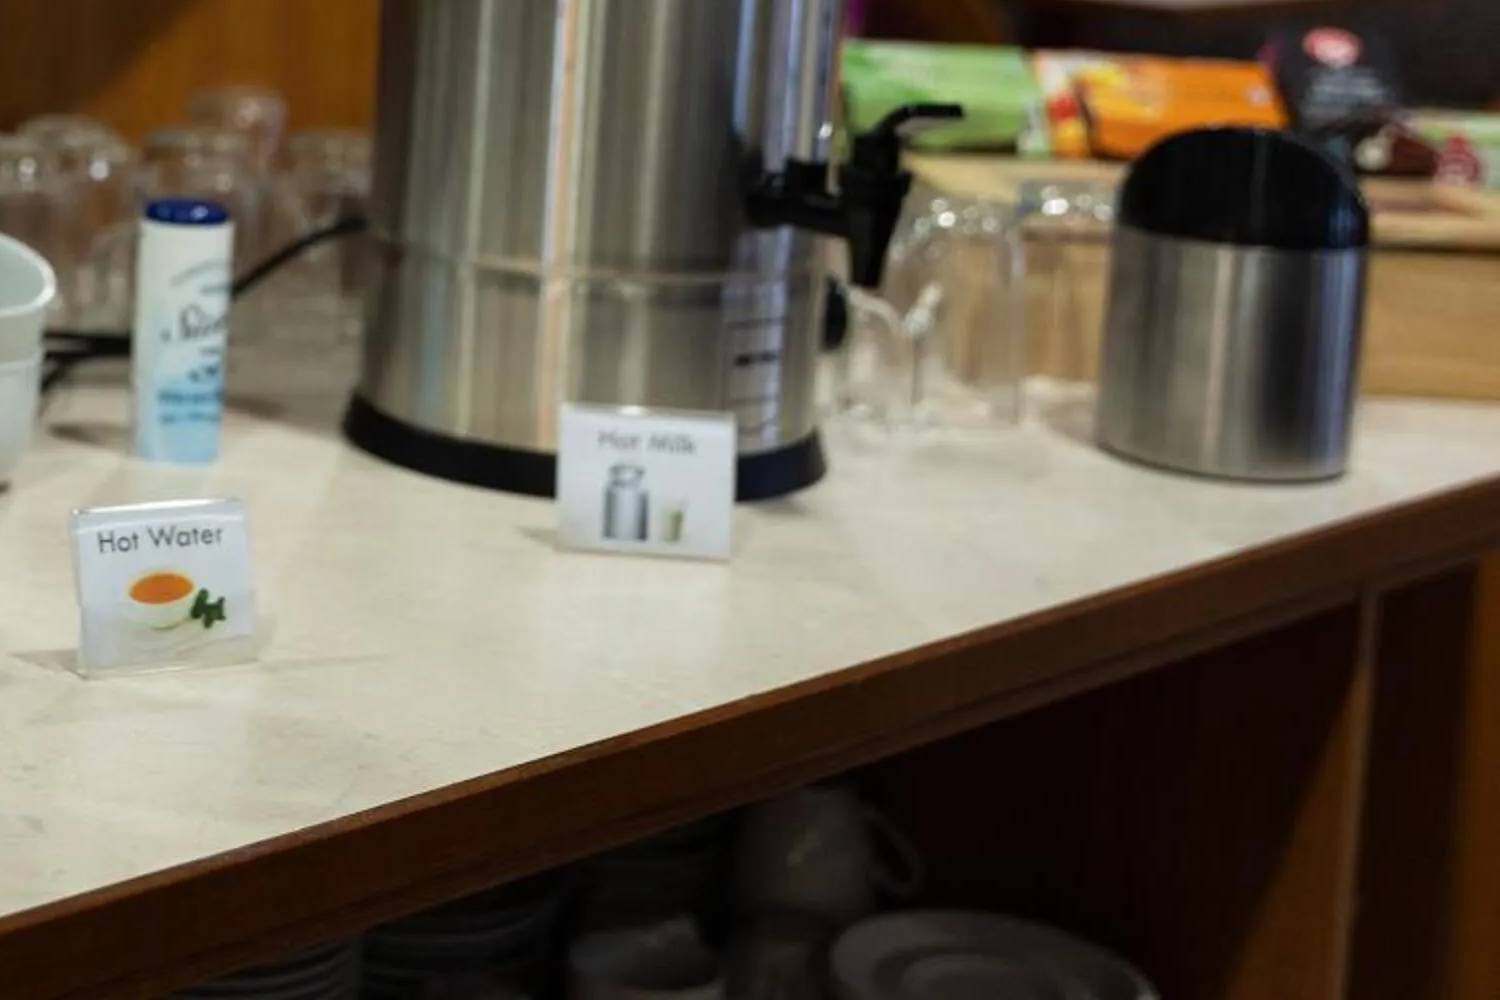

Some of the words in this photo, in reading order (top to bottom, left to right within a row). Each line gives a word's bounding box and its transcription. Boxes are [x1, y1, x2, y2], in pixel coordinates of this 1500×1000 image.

[597, 429, 640, 451] Hot
[647, 432, 697, 455] Milk
[97, 530, 139, 553] Hot
[147, 525, 224, 549] Water
